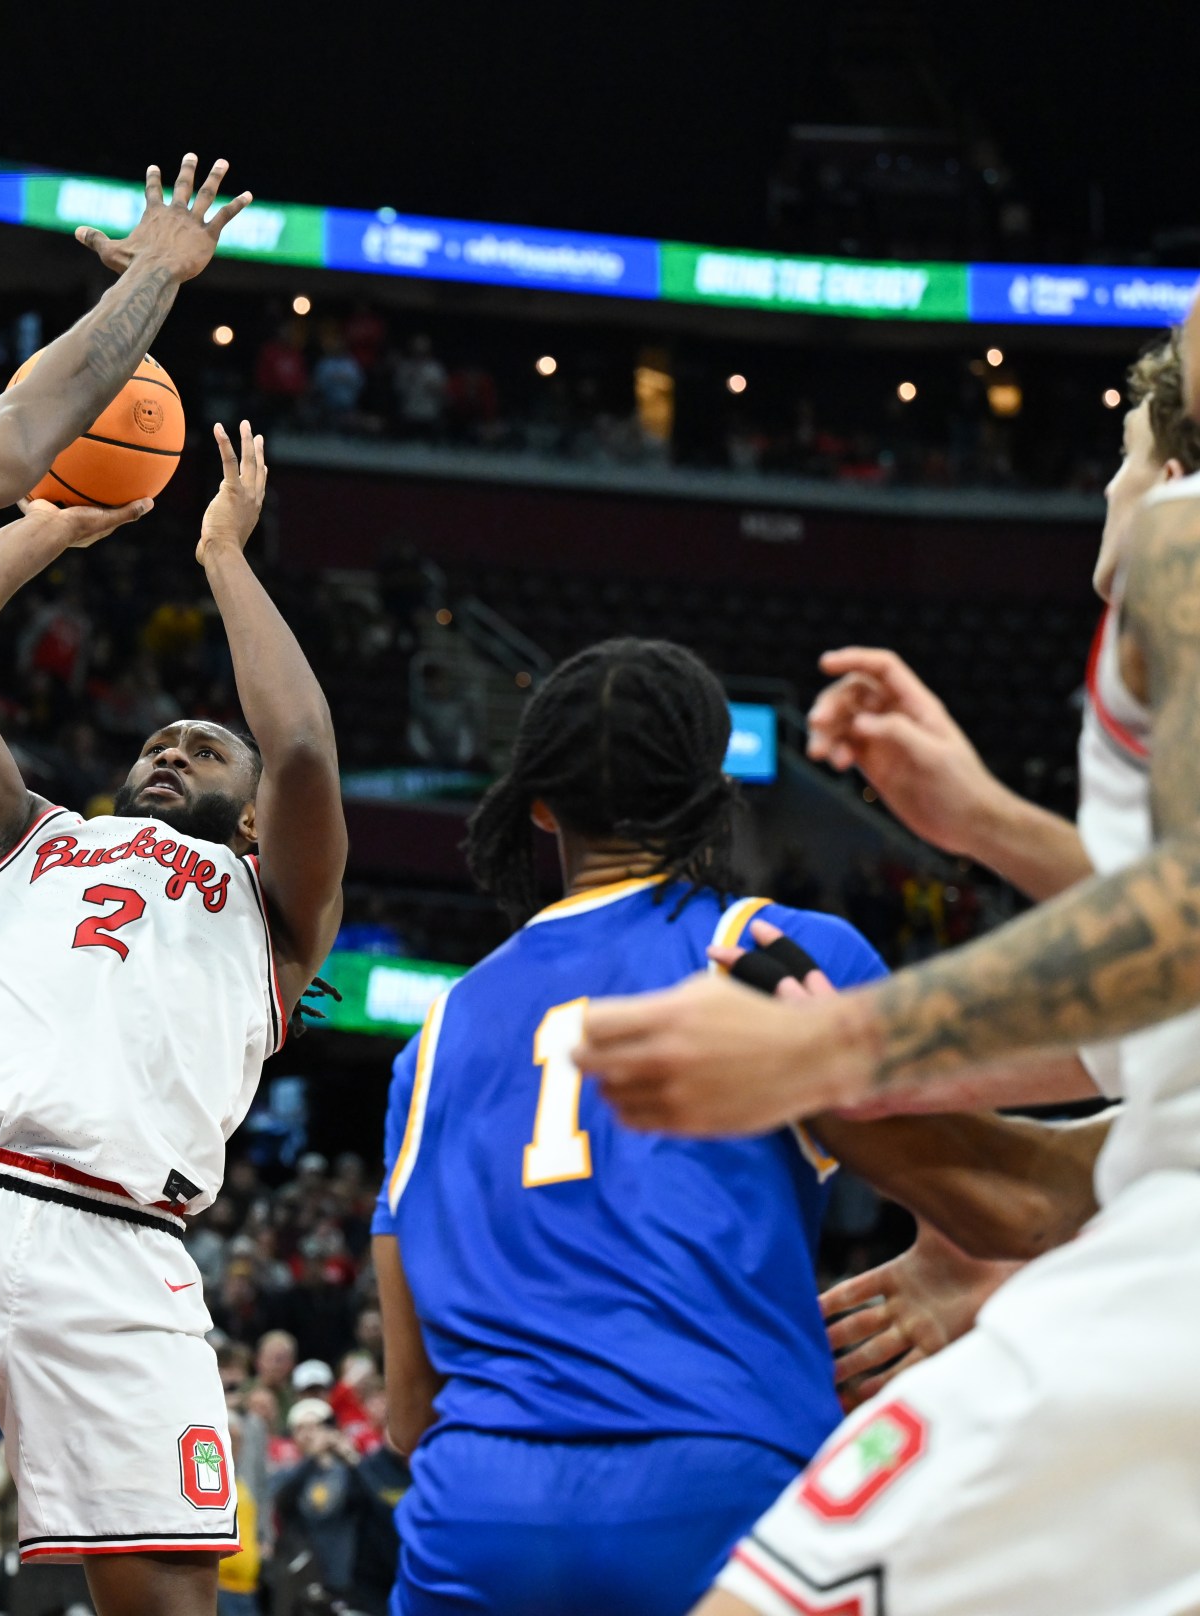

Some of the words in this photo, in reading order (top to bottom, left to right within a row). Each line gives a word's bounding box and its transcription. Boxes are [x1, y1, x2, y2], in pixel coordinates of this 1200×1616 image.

[30, 827, 231, 913] Buckeyes
[72, 883, 146, 962] 2
[522, 996, 592, 1189] 1
